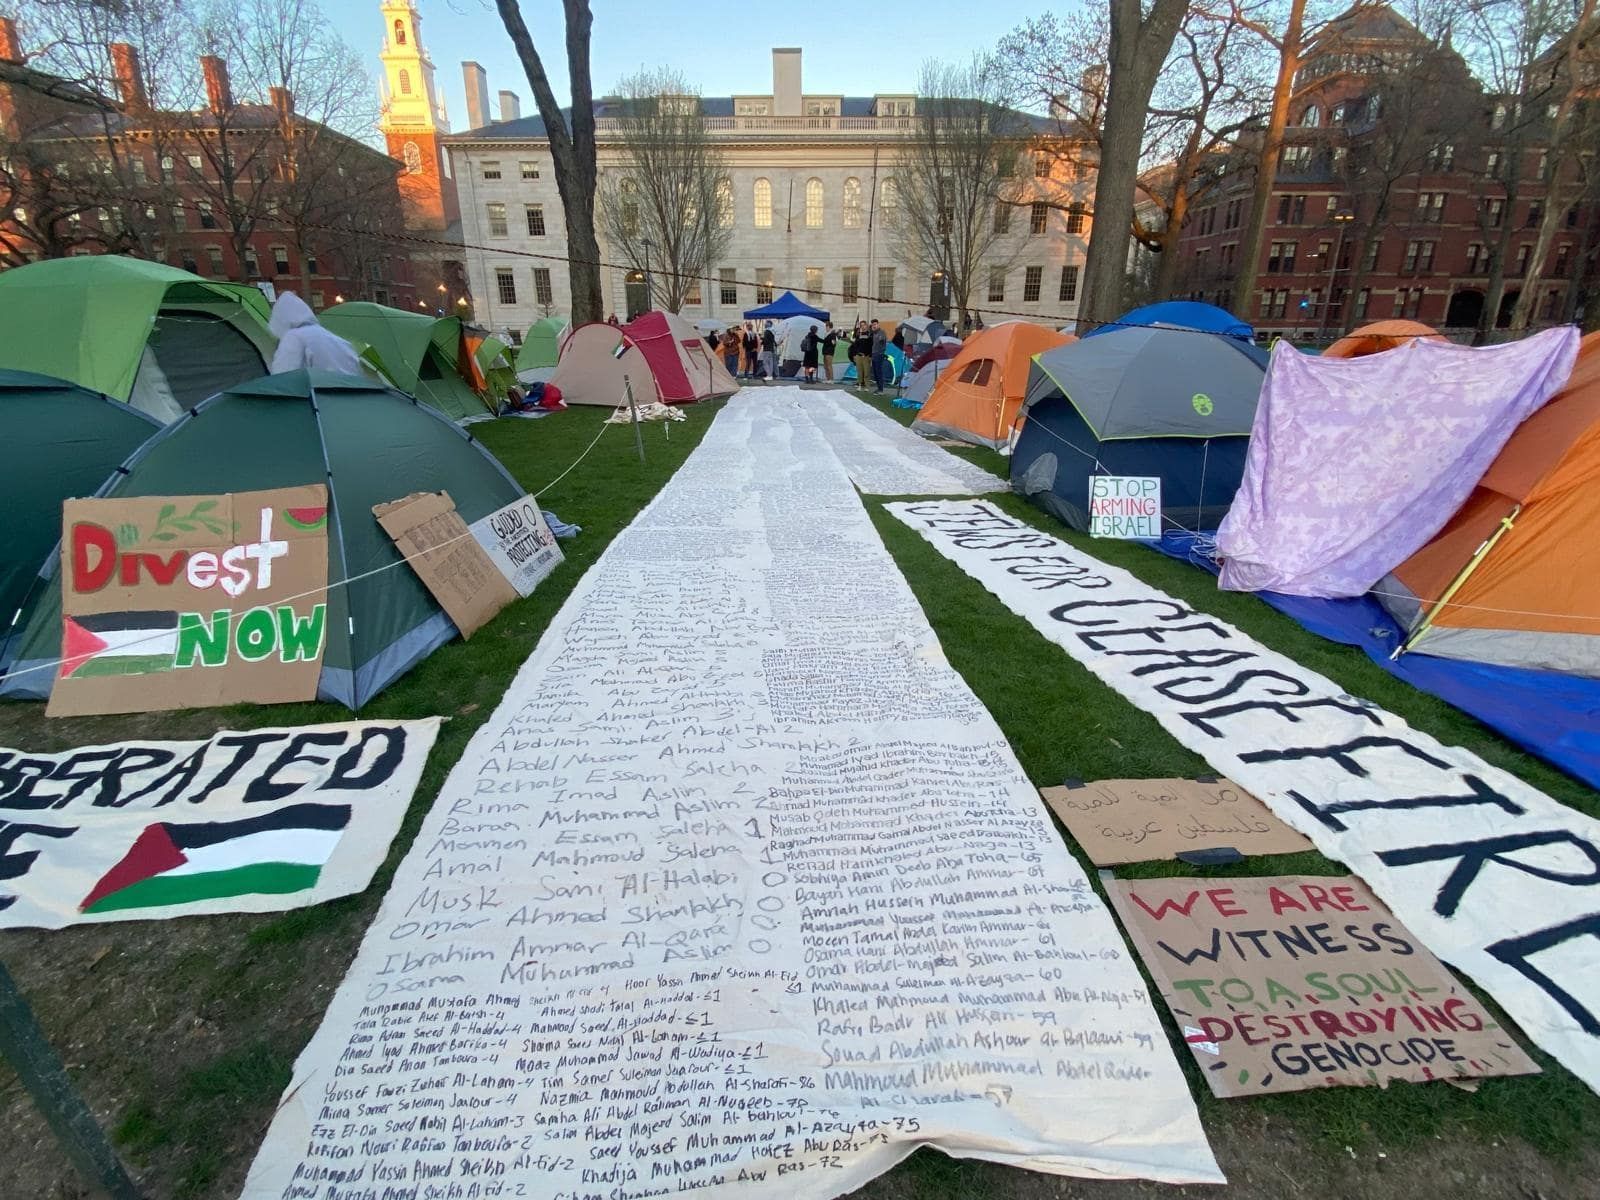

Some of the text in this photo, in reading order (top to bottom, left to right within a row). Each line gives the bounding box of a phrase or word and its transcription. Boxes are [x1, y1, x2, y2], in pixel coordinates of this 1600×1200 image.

[1094, 478, 1157, 497] STOP
[1090, 498, 1156, 516] ARMING
[1091, 516, 1160, 537] ISRAEL
[905, 504, 1057, 549] JEWS
[990, 556, 1112, 590] FOR
[174, 603, 327, 668] NOW
[479, 754, 560, 776] Abdel
[1176, 814, 1271, 839] فلسطين
[423, 856, 502, 881] Amal
[506, 899, 608, 927] Ahmed
[1130, 888, 1248, 920] WE
[1269, 885, 1370, 916] ARE
[376, 936, 608, 975] Ibrahim Ammar
[1156, 922, 1415, 966] WITNESS
[1173, 967, 1439, 1008] TO A SOUL
[1197, 999, 1484, 1046] DESTROYING
[1271, 1037, 1466, 1075] GENOCIDE
